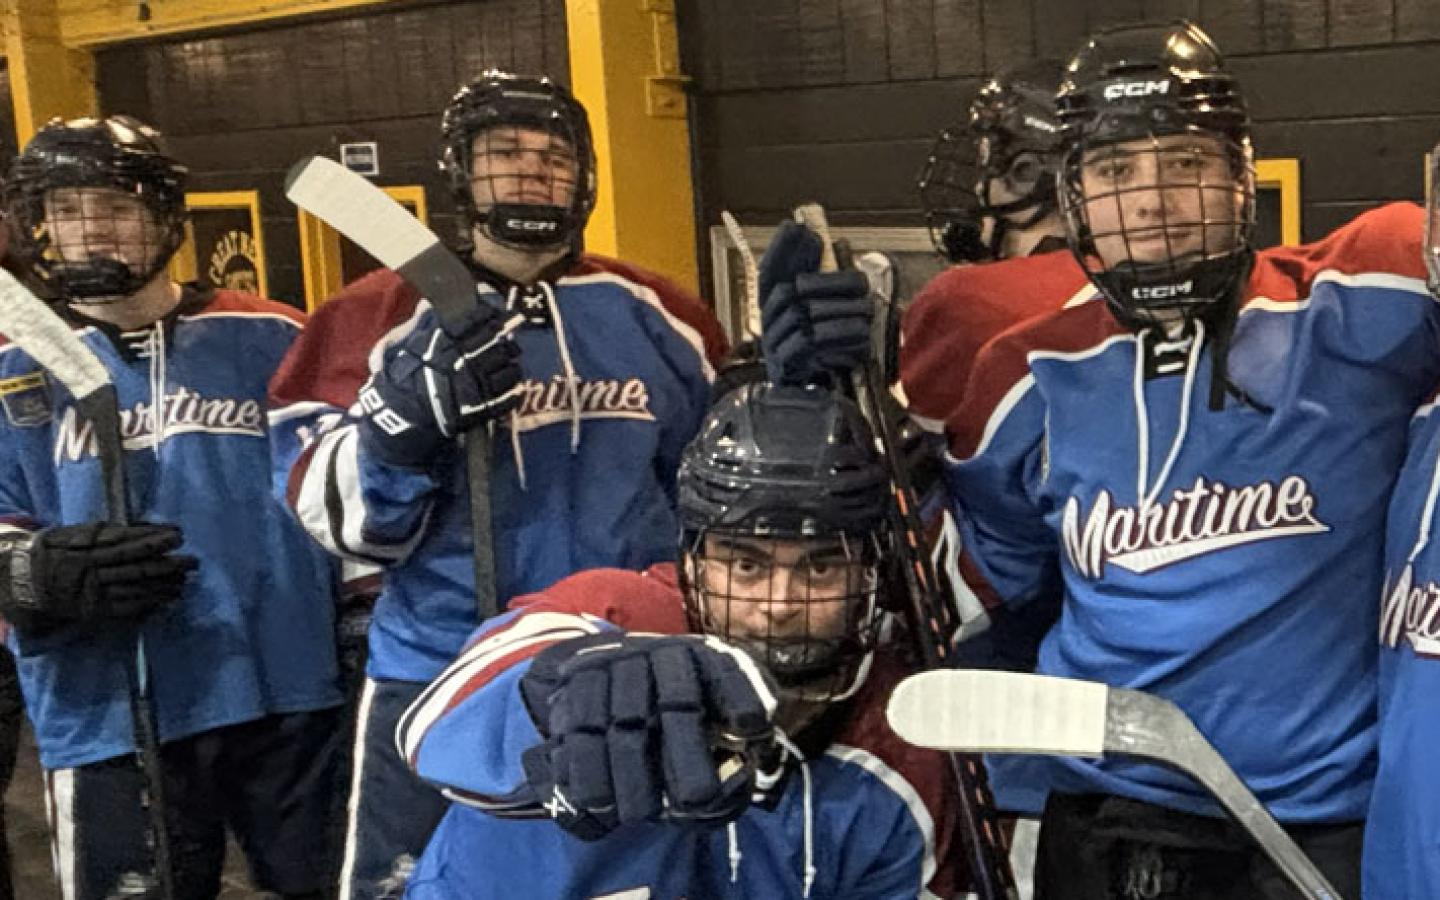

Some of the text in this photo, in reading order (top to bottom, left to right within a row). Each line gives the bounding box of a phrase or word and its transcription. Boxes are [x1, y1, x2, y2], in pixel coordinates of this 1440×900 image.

[1103, 80, 1170, 99] CCM
[506, 218, 557, 231] CCM
[54, 386, 264, 468] Mrtime
[1060, 474, 1332, 579] Maritime
